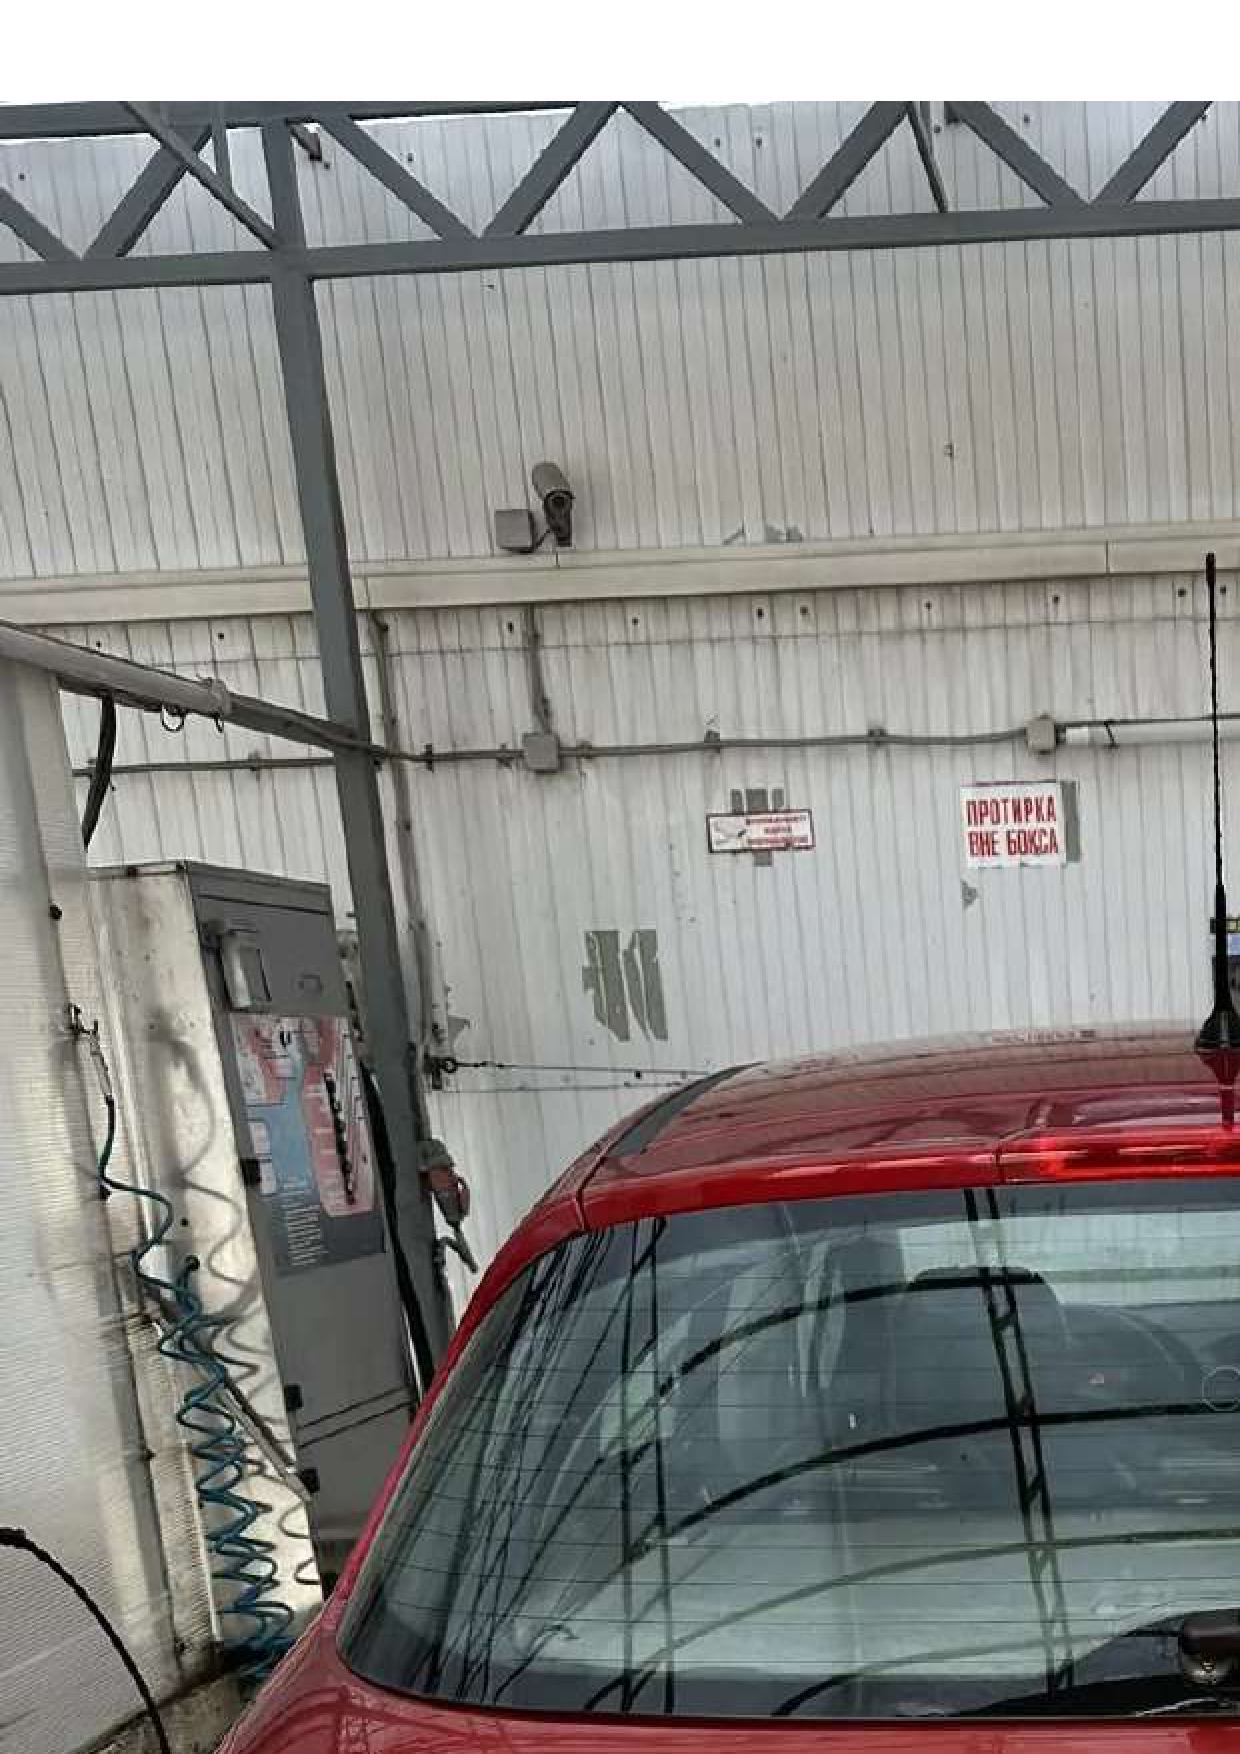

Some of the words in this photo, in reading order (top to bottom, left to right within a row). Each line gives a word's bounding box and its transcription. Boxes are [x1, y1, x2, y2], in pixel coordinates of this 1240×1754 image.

[966, 795, 1056, 825] ПРОТИРКА
[968, 831, 1000, 857] ВНЕ
[1006, 828, 1059, 856] БОКСА
